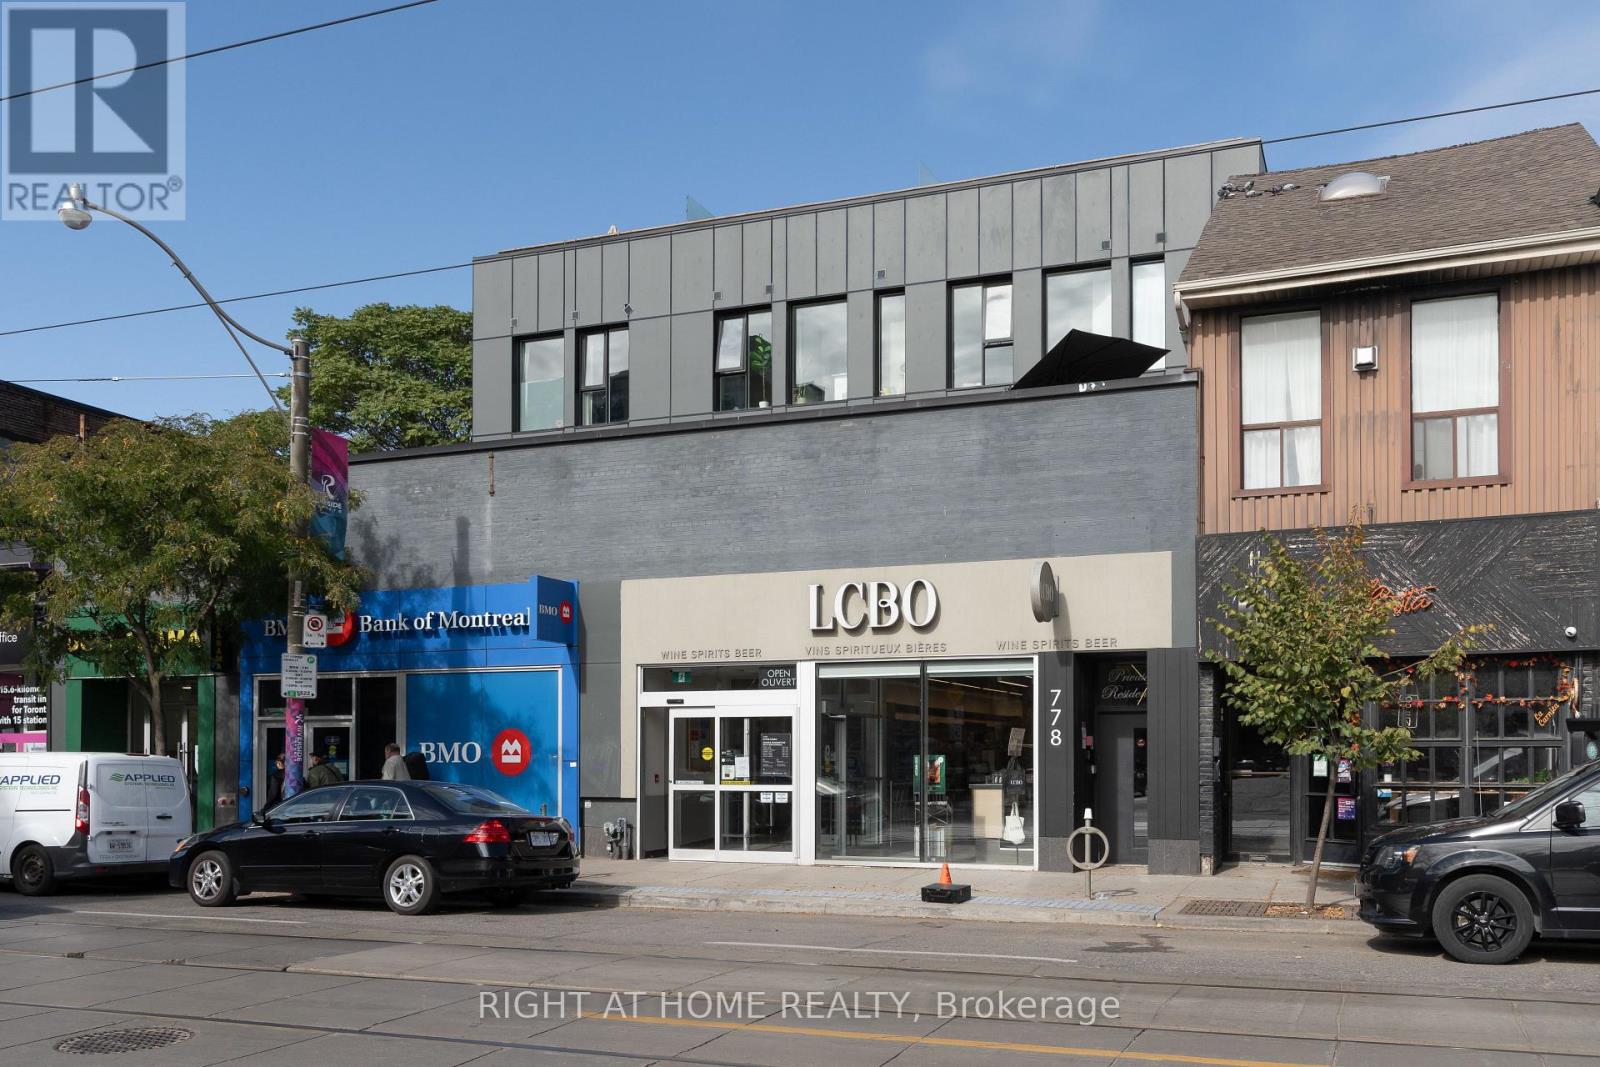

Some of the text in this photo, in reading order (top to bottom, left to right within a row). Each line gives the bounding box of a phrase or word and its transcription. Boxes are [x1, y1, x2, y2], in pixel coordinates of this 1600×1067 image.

[539, 604, 558, 616] BMO
[808, 579, 938, 630] LCBO
[264, 607, 530, 636] BM Bank of Montreal
[805, 641, 948, 656] VINS SPIRITUEUX BIÈRES
[997, 638, 1118, 650] WINE SPIRITS BEER
[661, 648, 762, 660] WINE SPIRITS BEER
[767, 669, 791, 678] OPEN
[761, 677, 797, 687] OUVERT
[13, 695, 36, 704] transit
[12, 705, 47, 714] for Toront
[13, 716, 22, 724] 15
[23, 714, 47, 725] station
[420, 741, 482, 764] BMO
[0, 774, 61, 785] APPLIED
[124, 773, 176, 783] APPLIED
